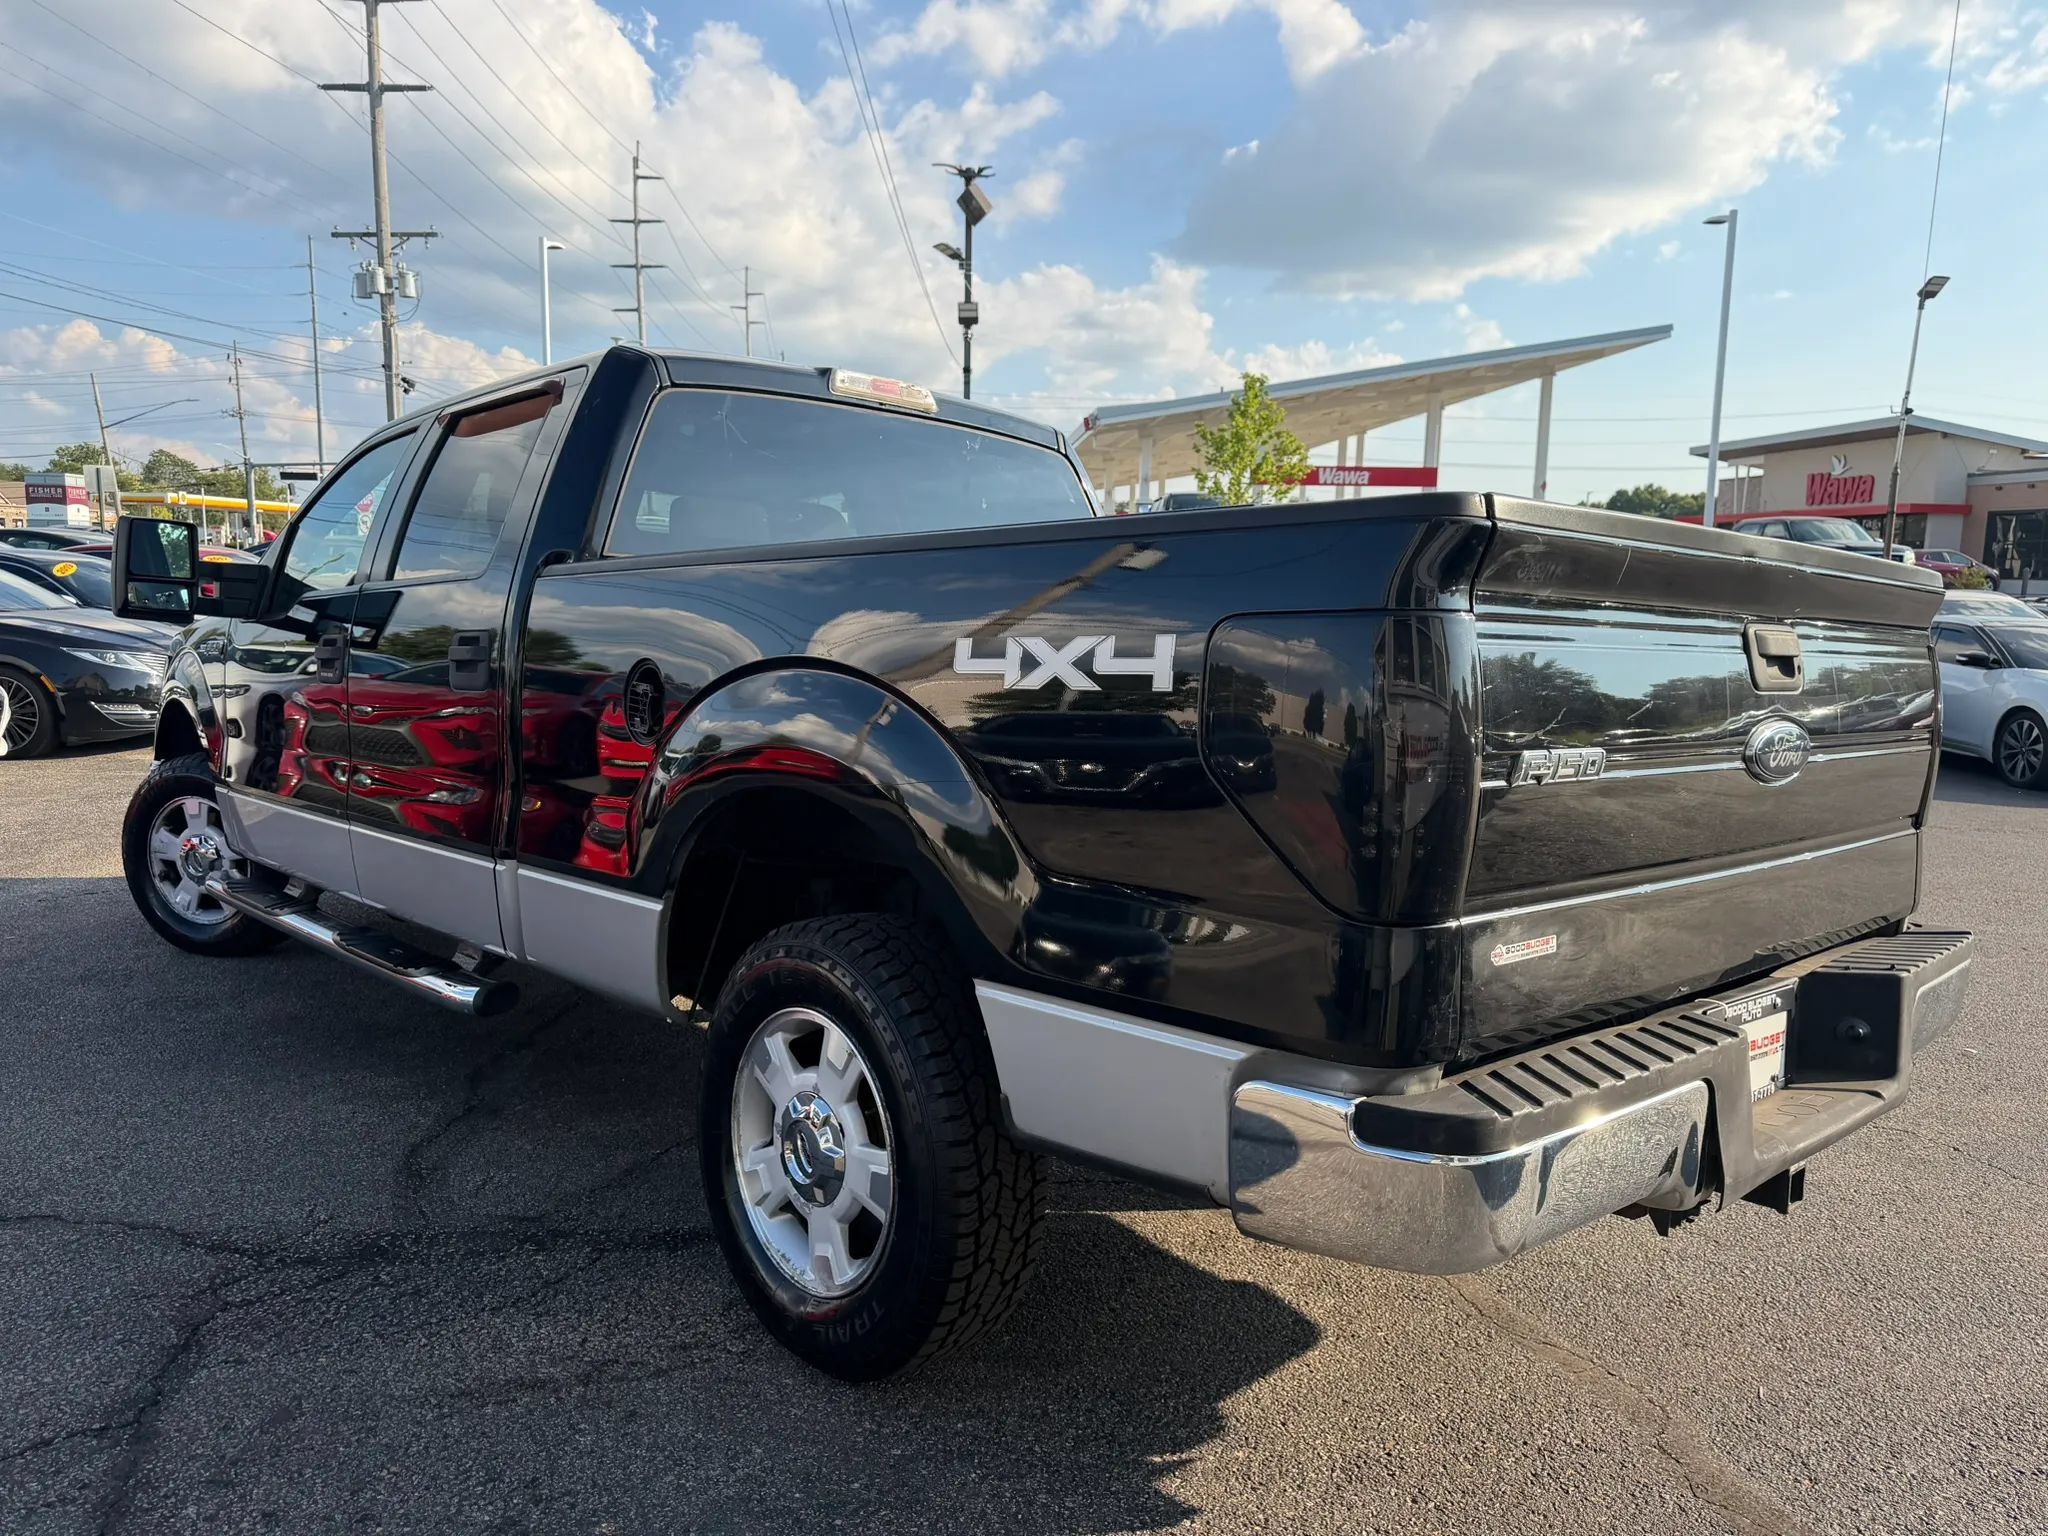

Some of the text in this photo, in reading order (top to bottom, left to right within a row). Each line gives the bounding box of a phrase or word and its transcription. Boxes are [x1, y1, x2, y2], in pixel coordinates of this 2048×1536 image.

[1319, 467, 1369, 485] Wawa
[28, 486, 63, 495] FISHER
[1806, 472, 1875, 506] Wawa
[1770, 733, 1802, 768] Ford
[1741, 1008, 1762, 1023] AUTO
[1750, 1030, 1786, 1052] BUDGET
